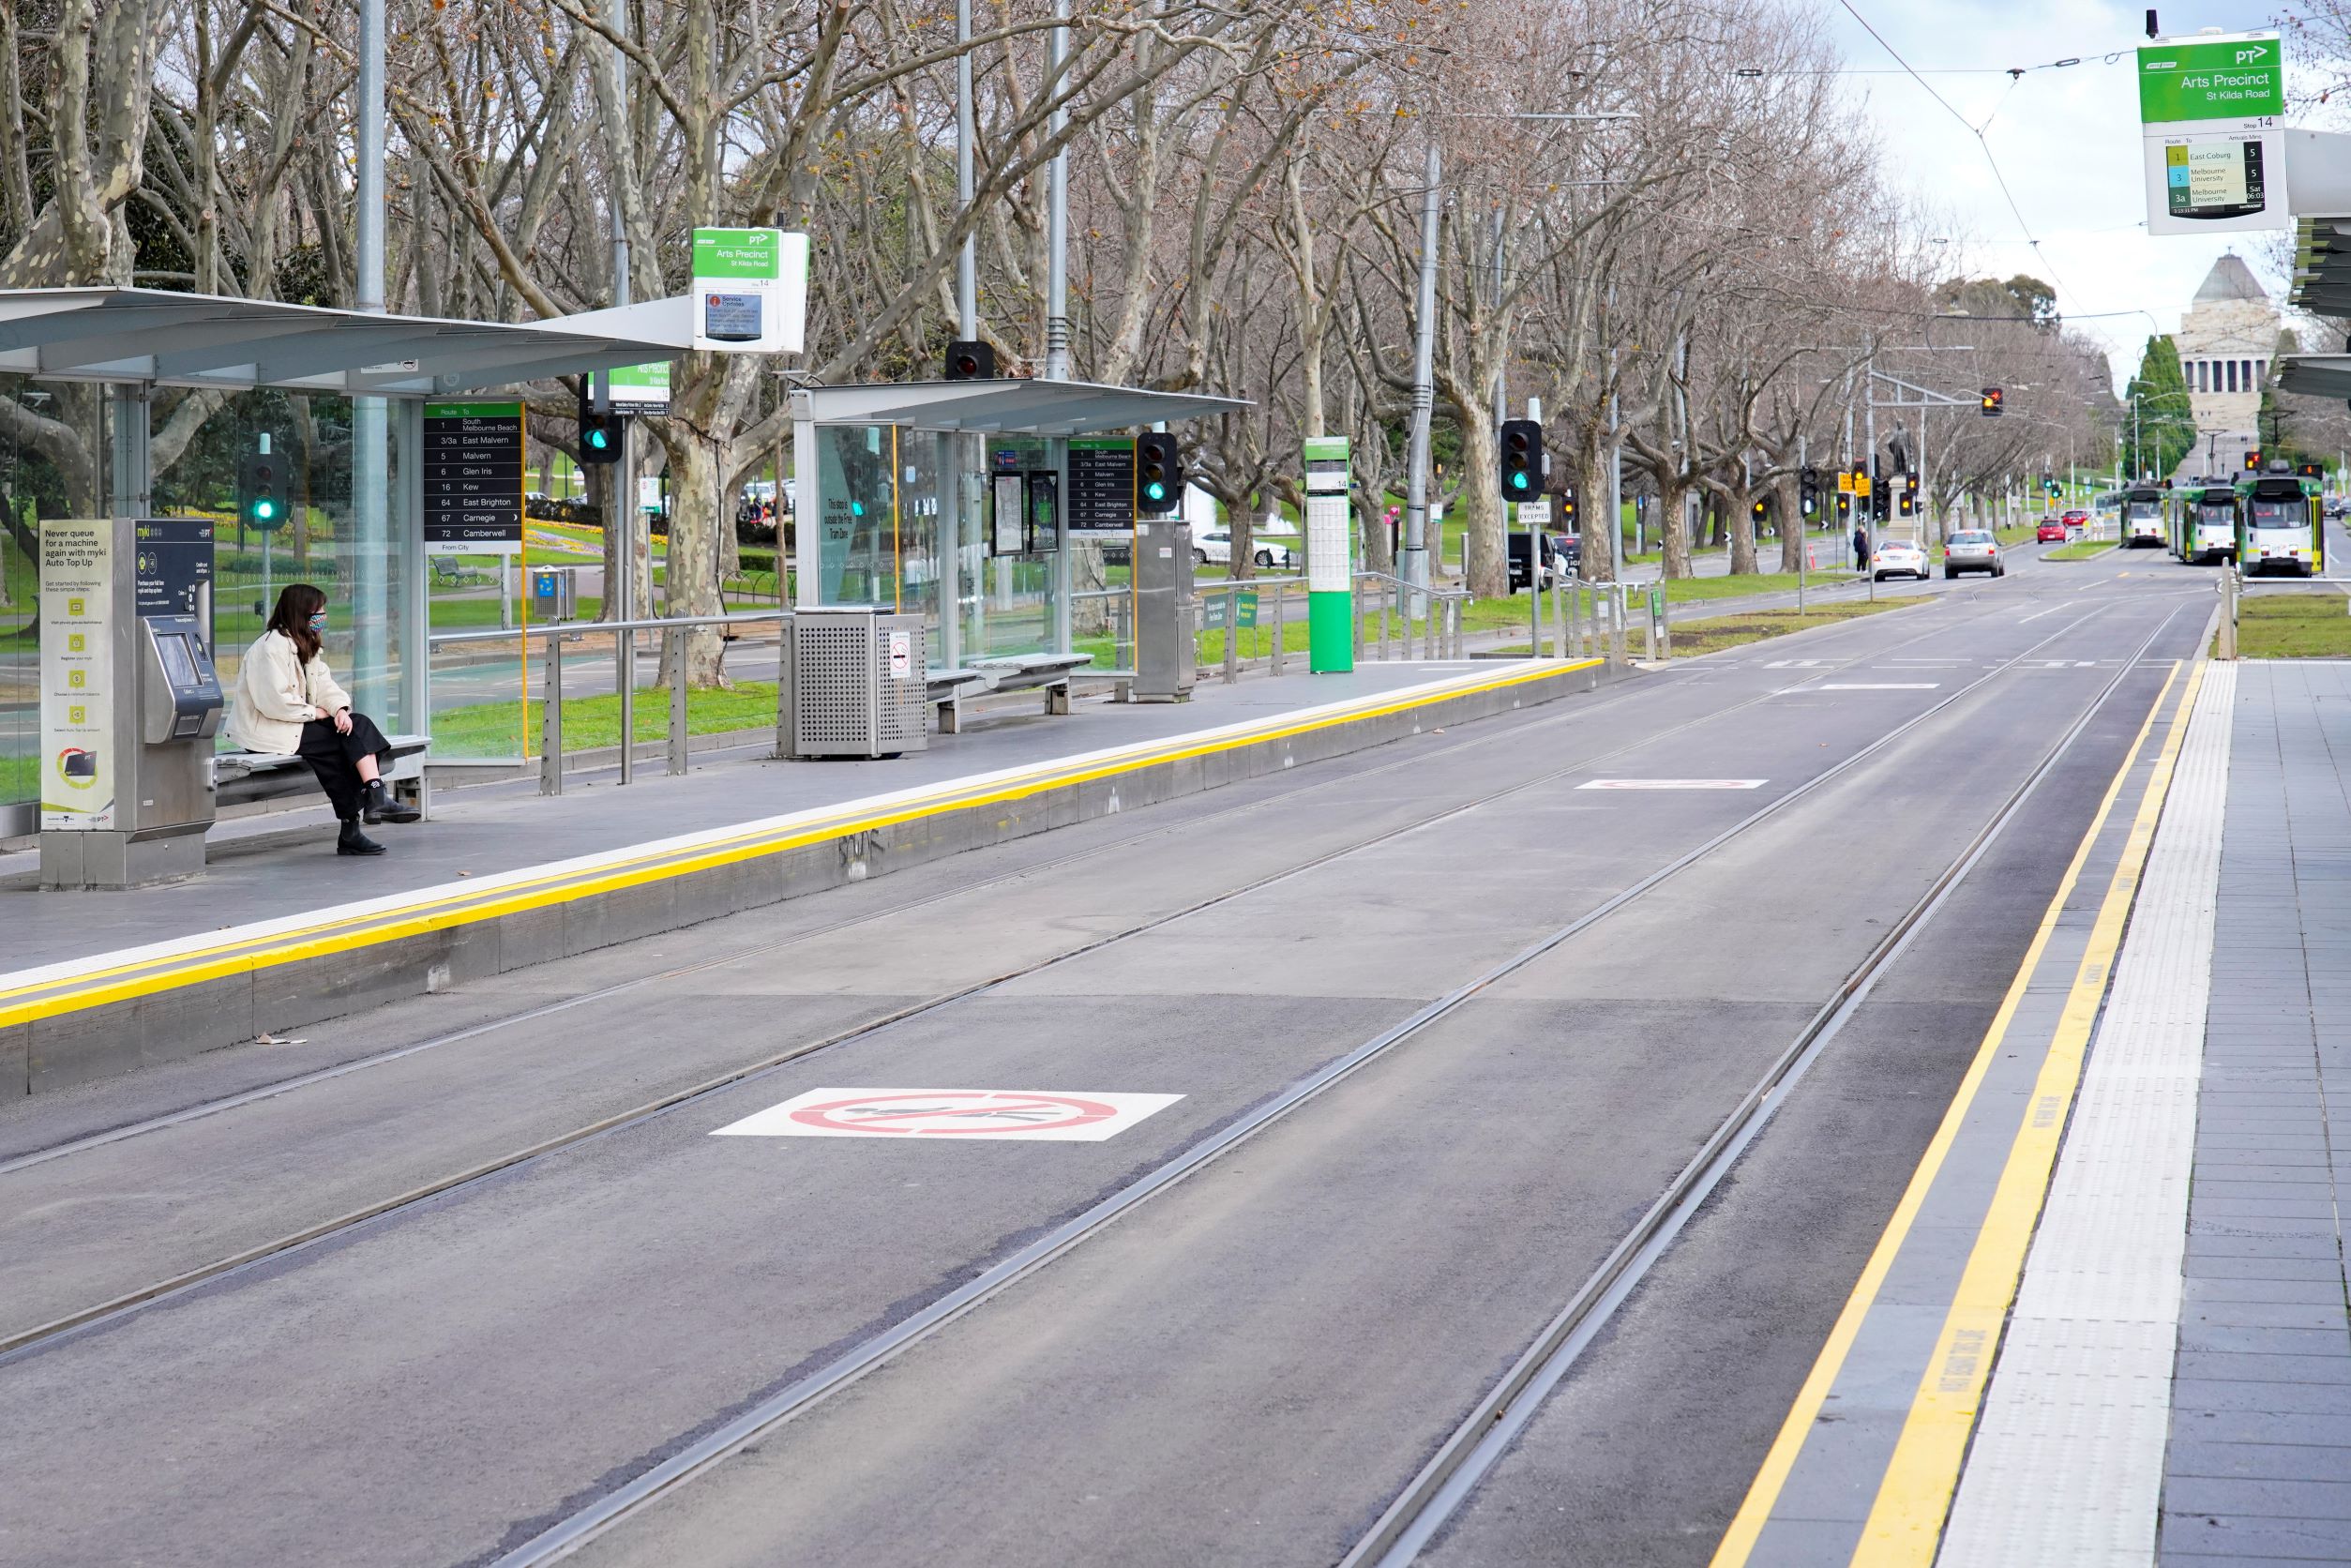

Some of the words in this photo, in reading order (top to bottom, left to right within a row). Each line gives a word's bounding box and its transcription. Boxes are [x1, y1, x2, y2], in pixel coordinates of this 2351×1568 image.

[2181, 77, 2209, 88] Arts
[2214, 73, 2269, 86] Precinct
[2207, 92, 2216, 100] St
[2220, 91, 2242, 99] Kilda
[2245, 89, 2270, 98] Road
[2258, 117, 2272, 128] 14
[2191, 167, 2226, 175] Melbourne
[2176, 194, 2186, 203] 3a
[2192, 195, 2225, 204] University
[716, 249, 733, 258] Arts
[735, 249, 768, 259] Precinct
[481, 498, 511, 507] Brighton
[463, 514, 496, 523] Carnegie
[824, 513, 836, 524] outside
[844, 513, 852, 524] Free
[137, 525, 149, 540] myki
[45, 550, 67, 558] again
[87, 549, 107, 559] myki
[67, 559, 81, 567] Top
[82, 559, 93, 567] Up
